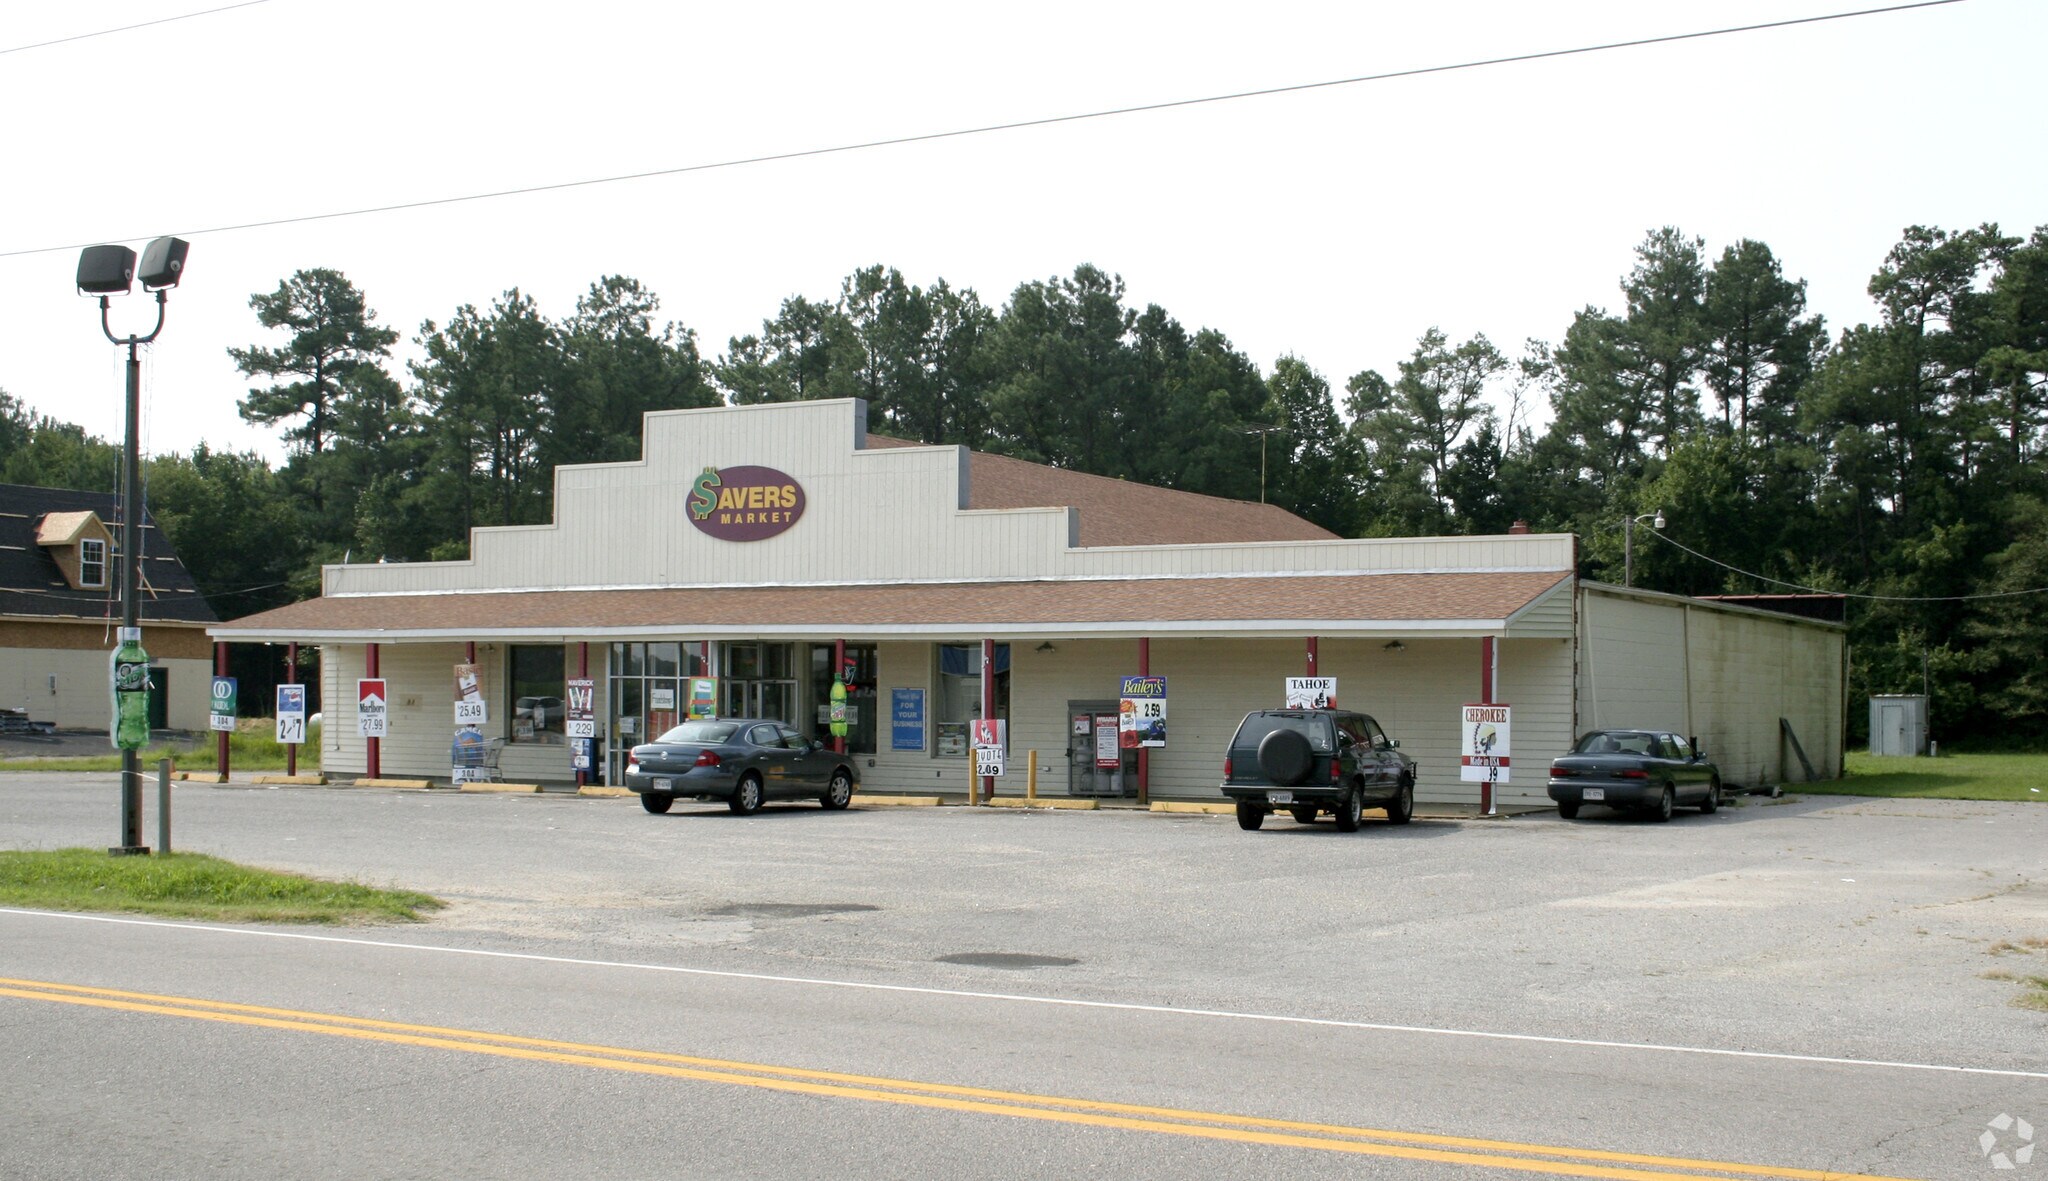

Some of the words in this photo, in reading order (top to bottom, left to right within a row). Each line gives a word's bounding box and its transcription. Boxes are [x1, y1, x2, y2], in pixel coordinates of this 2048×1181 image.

[721, 511, 792, 524] MARKET
[567, 679, 594, 687] MAVERICK
[1123, 680, 1163, 695] Bailey's
[1291, 679, 1330, 689] TAHOE
[360, 700, 385, 714] Marlboro
[900, 702, 915, 710] FOR
[898, 711, 918, 719] YOUR
[1465, 708, 1507, 723] CHEROKEE
[893, 720, 924, 729] BUSINESS
[454, 726, 483, 737] CAMEL
[1490, 757, 1500, 767] USA
